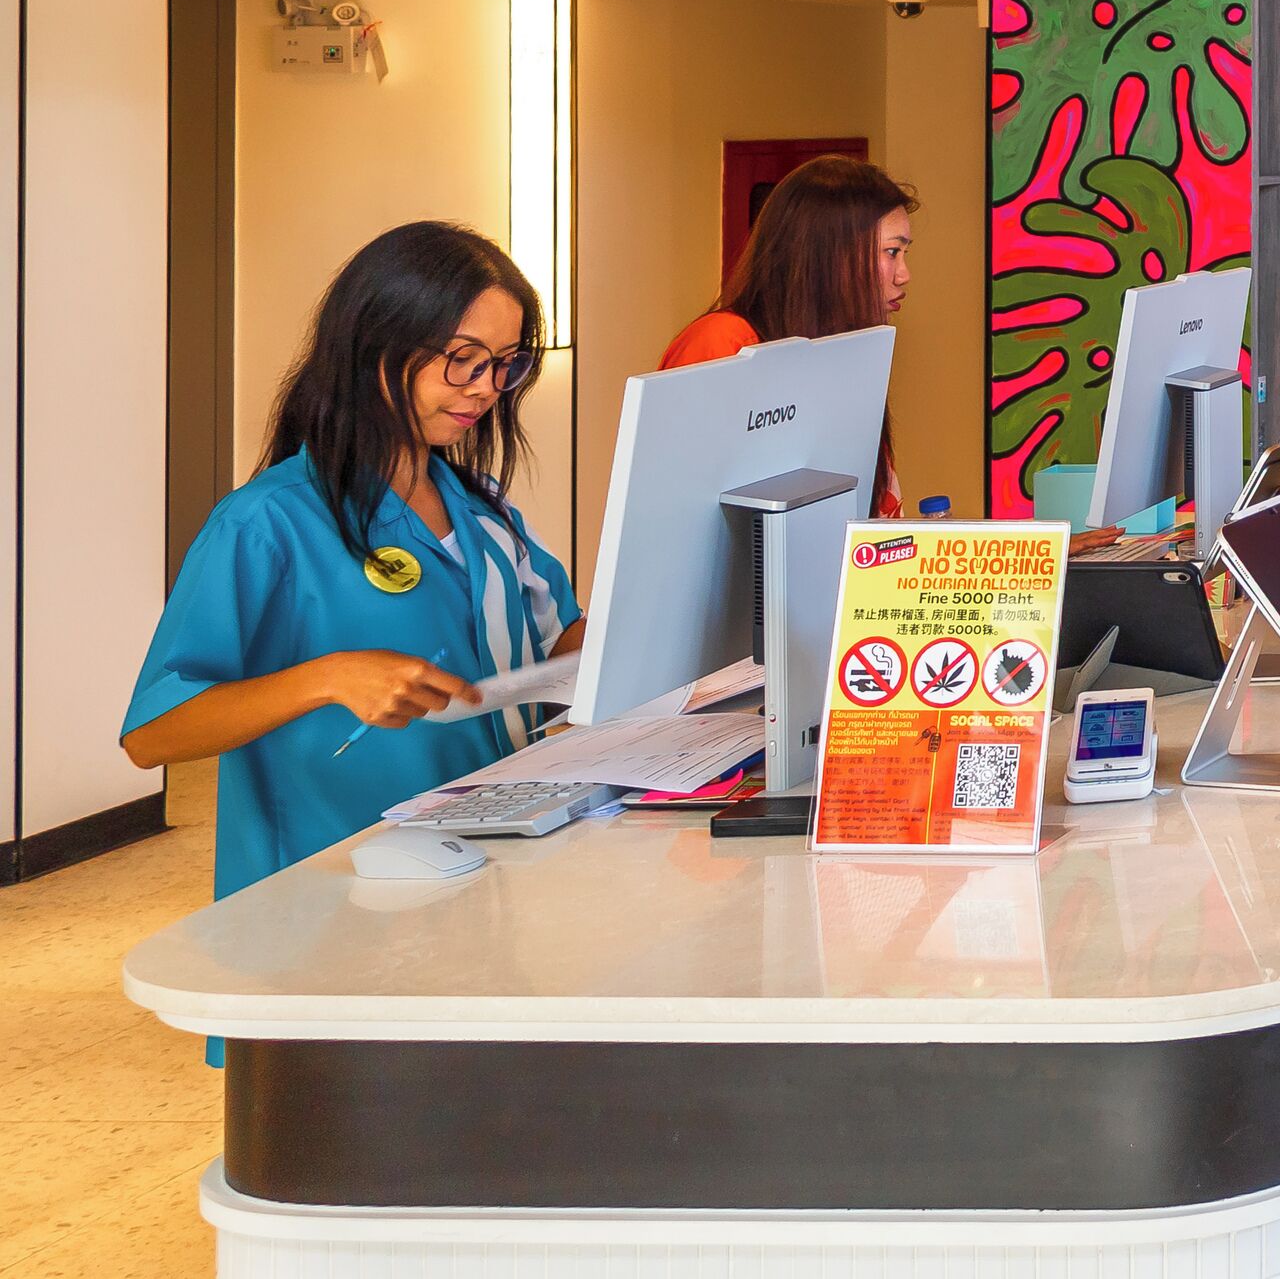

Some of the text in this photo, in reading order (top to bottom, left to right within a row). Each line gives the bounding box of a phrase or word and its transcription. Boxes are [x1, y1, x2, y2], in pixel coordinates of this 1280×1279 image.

[1180, 318, 1203, 335] Lenovo
[747, 402, 796, 431] Lenovo
[879, 537, 912, 550] ATTENTION
[936, 540, 1051, 557] NO VAPING
[880, 546, 914, 563] PLEASE!
[919, 558, 1054, 575] NO SMOKING
[897, 578, 1052, 590] NO DURIAN ALLOWED
[919, 593, 1033, 604] Fine 5000 Baht
[950, 716, 1034, 726] SOCIAL SPACE
